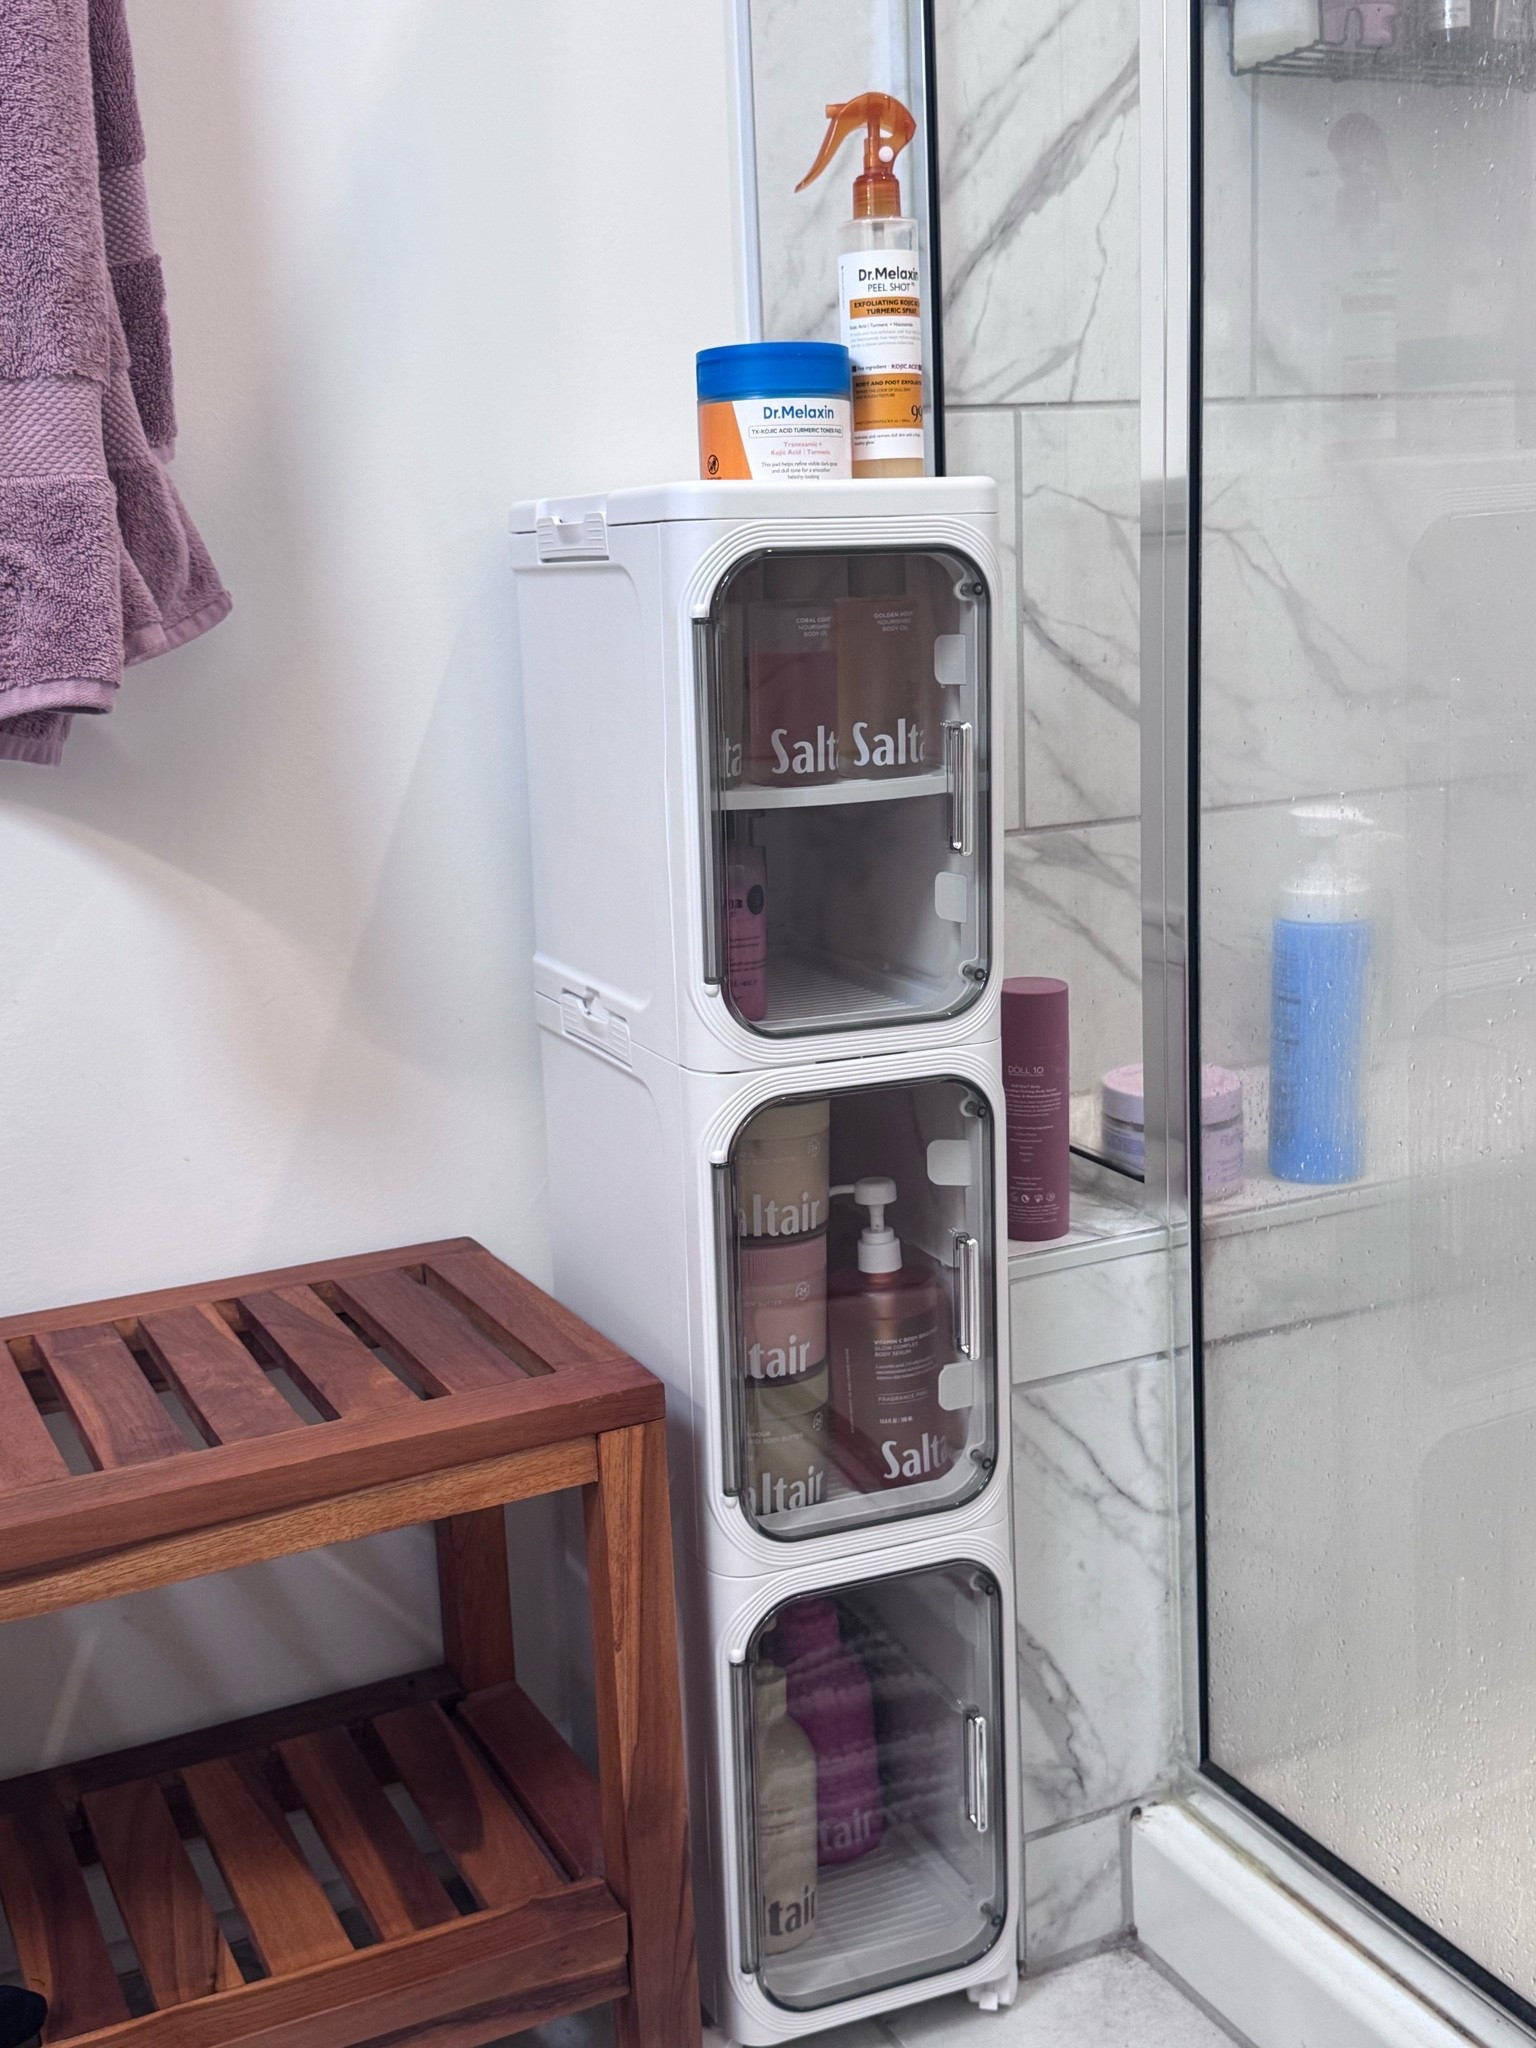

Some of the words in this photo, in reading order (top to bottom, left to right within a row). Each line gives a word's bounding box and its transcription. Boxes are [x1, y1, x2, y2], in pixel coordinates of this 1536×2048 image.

[867, 283, 887, 292] PEEL
[854, 299, 899, 308] EXFOLIATING
[867, 307, 901, 315] TURMERIC
[763, 404, 835, 419] Dr.Melaxin
[873, 611, 899, 619] GOLDEN
[771, 725, 839, 775] Salt
[877, 1393, 915, 1401] FRAGRANCE
